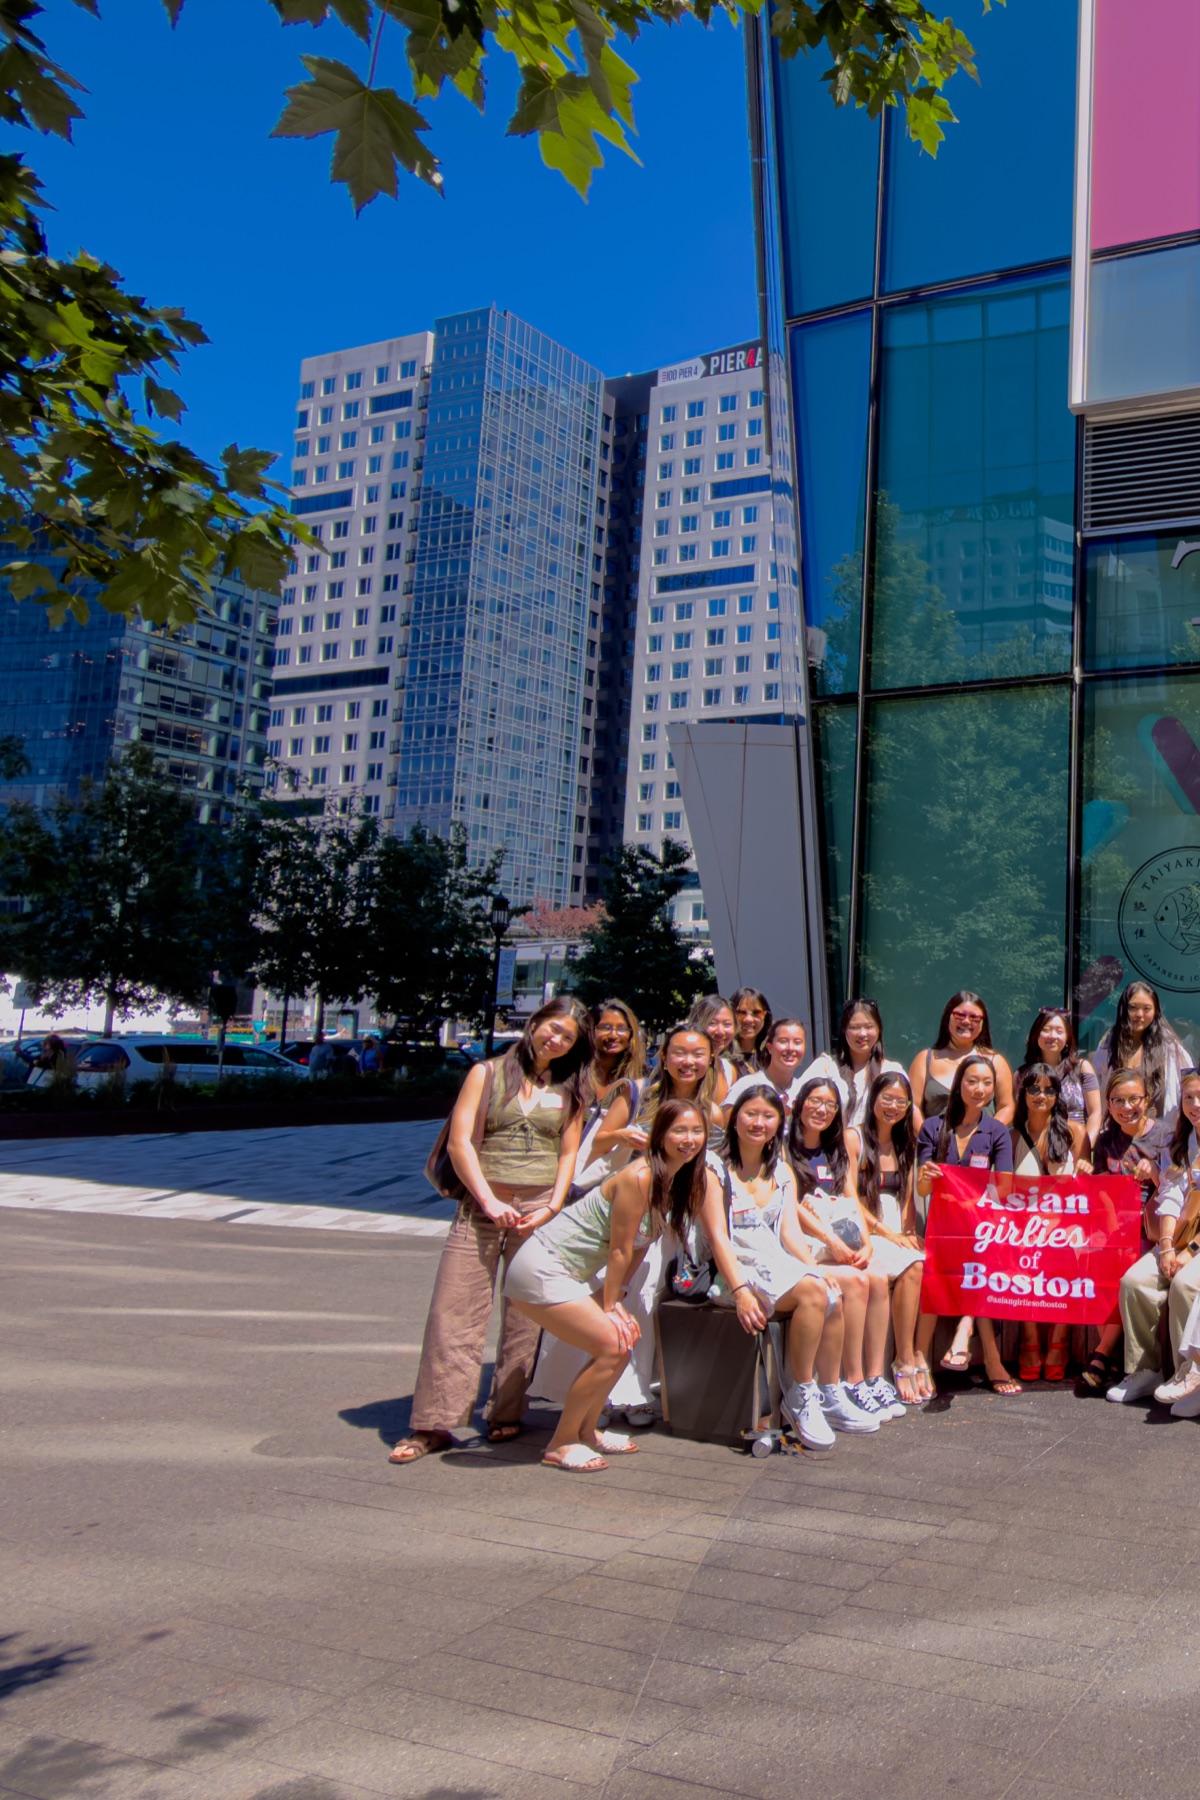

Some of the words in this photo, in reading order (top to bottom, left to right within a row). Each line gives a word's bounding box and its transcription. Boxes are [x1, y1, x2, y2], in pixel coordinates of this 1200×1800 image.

[666, 369, 677, 382] 100
[678, 367, 693, 380] PIER
[693, 366, 698, 376] 4
[1141, 857, 1200, 892] TAIYAKI
[1143, 952, 1185, 982] JAPANESE
[976, 1183, 1090, 1214] Asian
[973, 1215, 1090, 1253] girlies
[1019, 1252, 1042, 1269] of
[960, 1262, 1096, 1298] Boston
[986, 1295, 1068, 1309] @asiangirliesofboston
